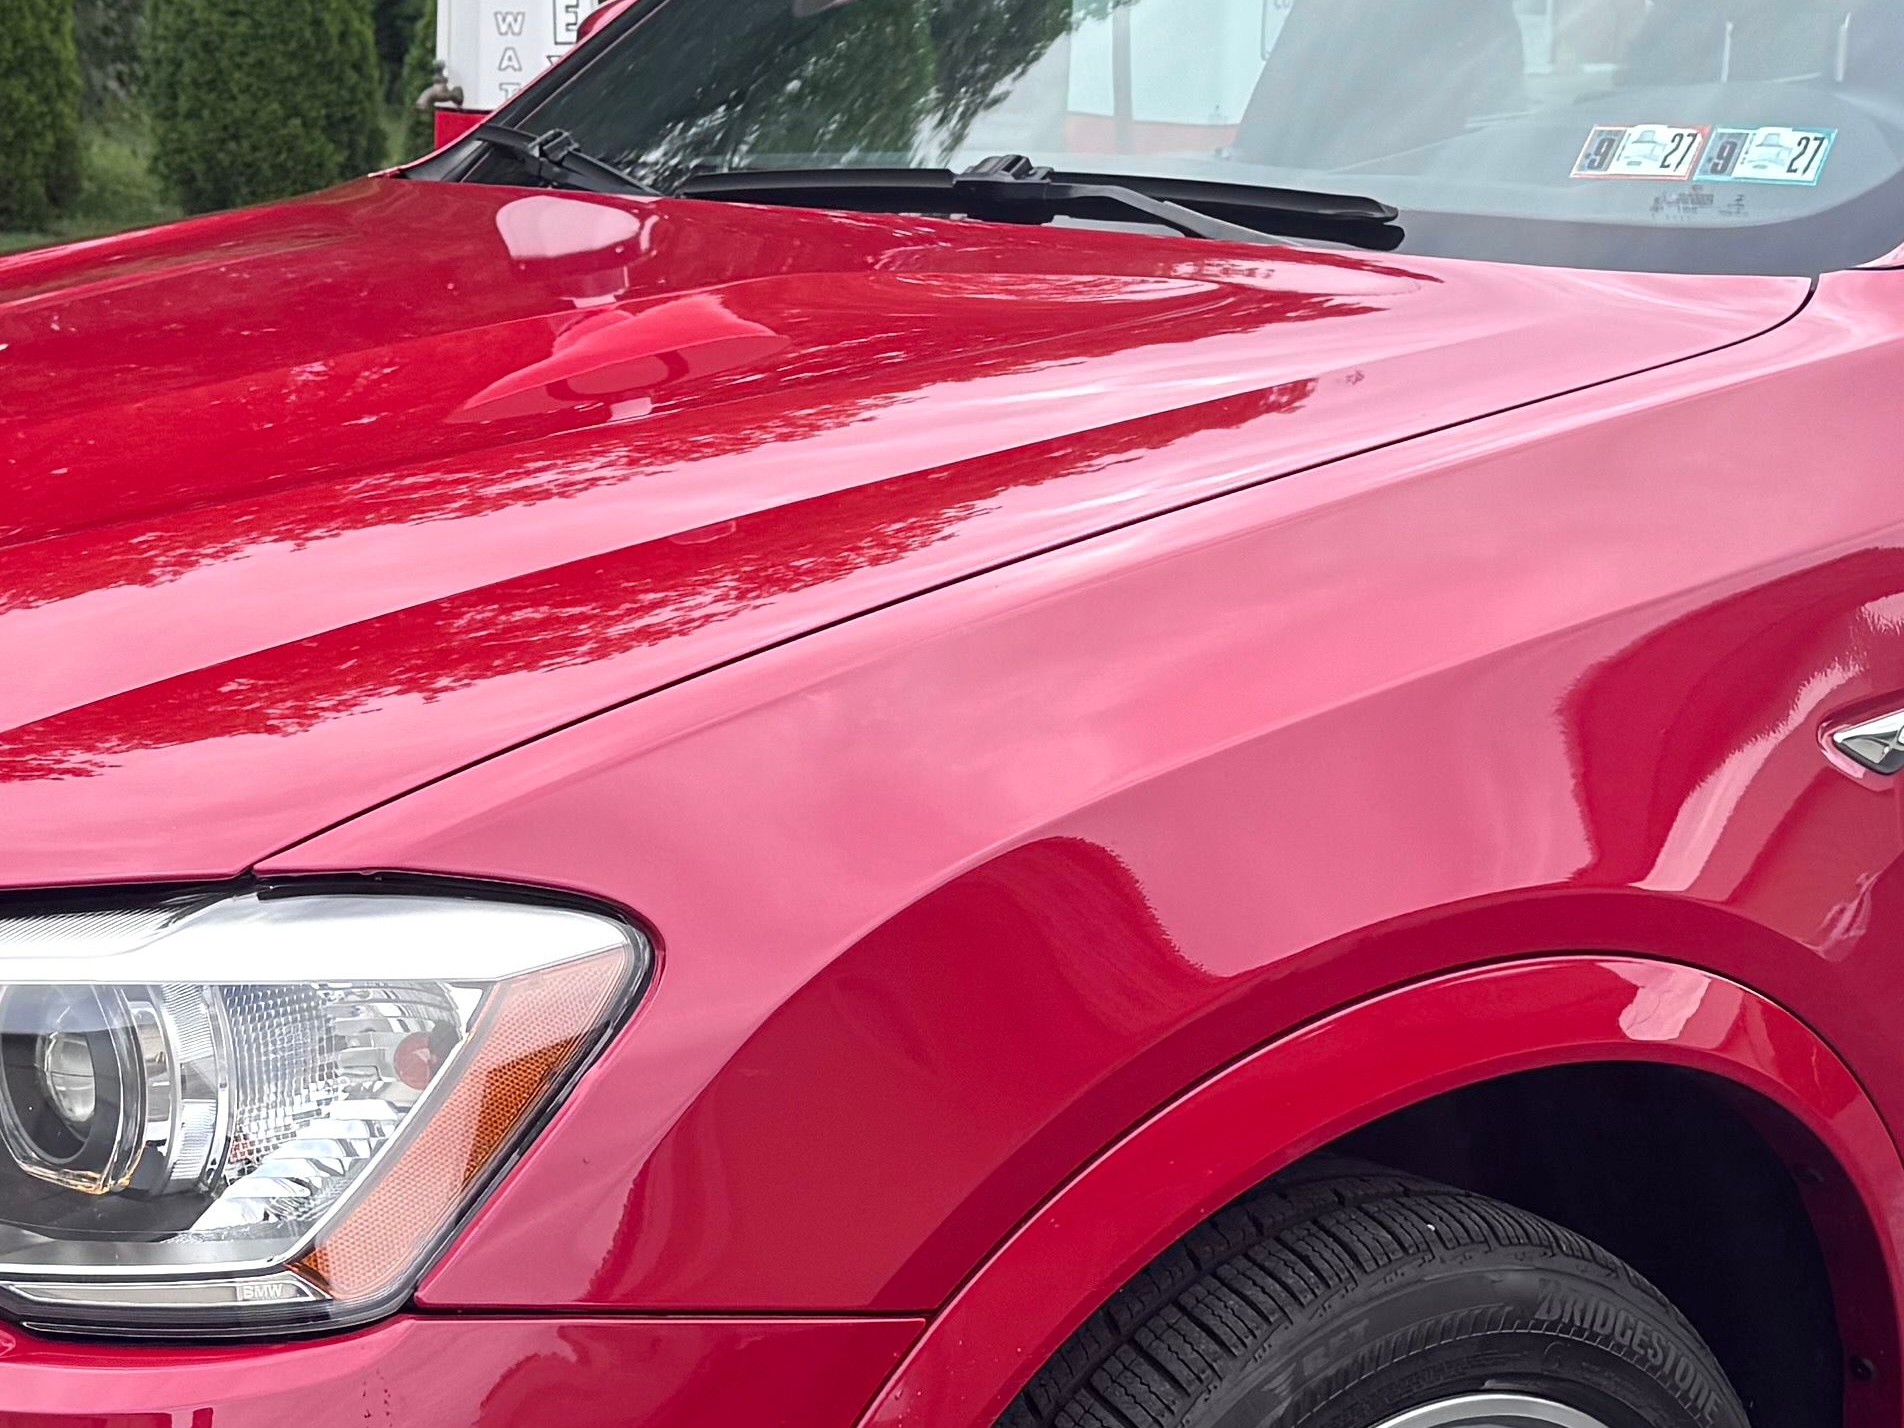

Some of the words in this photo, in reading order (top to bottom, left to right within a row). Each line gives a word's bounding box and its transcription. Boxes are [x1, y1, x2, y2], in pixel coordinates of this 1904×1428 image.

[1659, 132, 1698, 172] 27
[1786, 135, 1826, 176] 27
[243, 1283, 283, 1301] BMW
[1534, 1277, 1722, 1423] BRIDGESTONE
